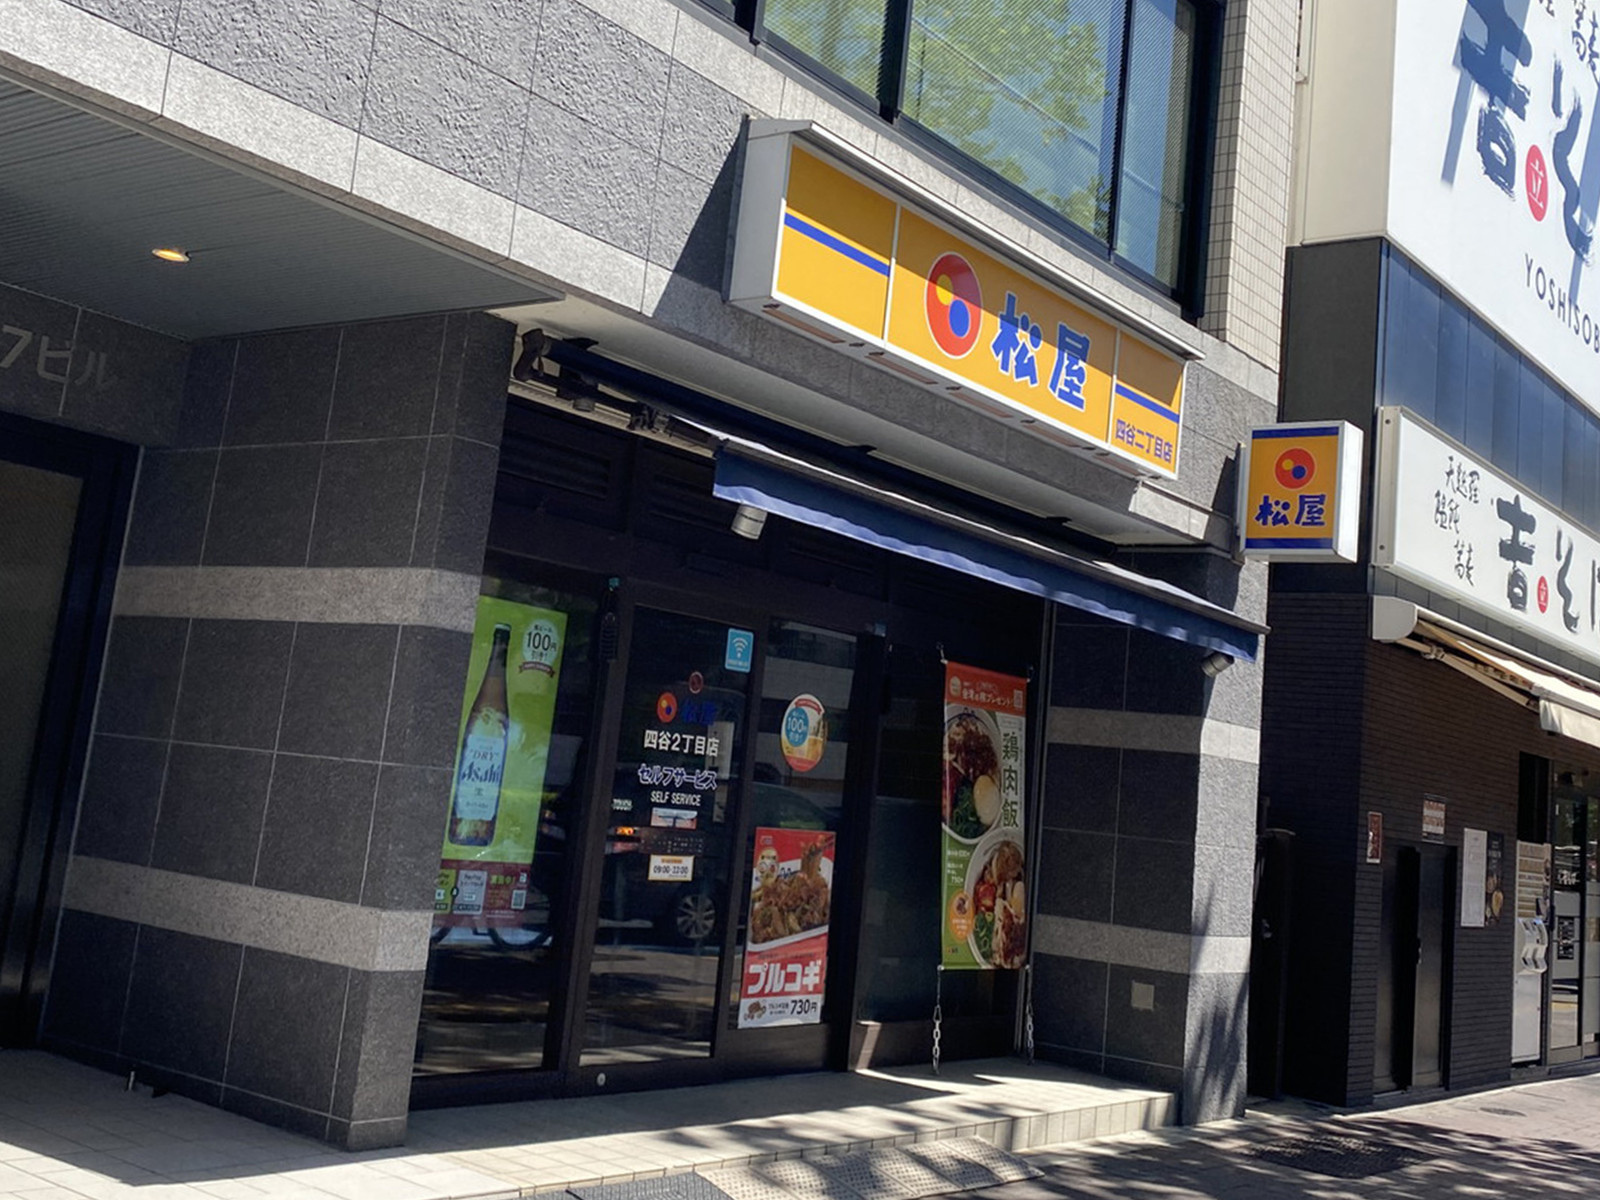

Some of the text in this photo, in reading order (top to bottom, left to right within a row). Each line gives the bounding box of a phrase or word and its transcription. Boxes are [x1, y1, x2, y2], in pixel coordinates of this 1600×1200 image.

[990, 290, 1091, 413] 松屋
[1114, 418, 1174, 464] 四谷二丁目店
[1254, 493, 1327, 527] 松屋
[643, 729, 720, 757] 四谷2丁目店
[461, 761, 501, 784] Asahi
[637, 763, 718, 791] セルフサービス
[1001, 731, 1020, 828] 鶏肉飯
[650, 790, 702, 807] SELF SERVICE
[746, 958, 822, 995] プルコギ
[790, 998, 818, 1015] 730円
